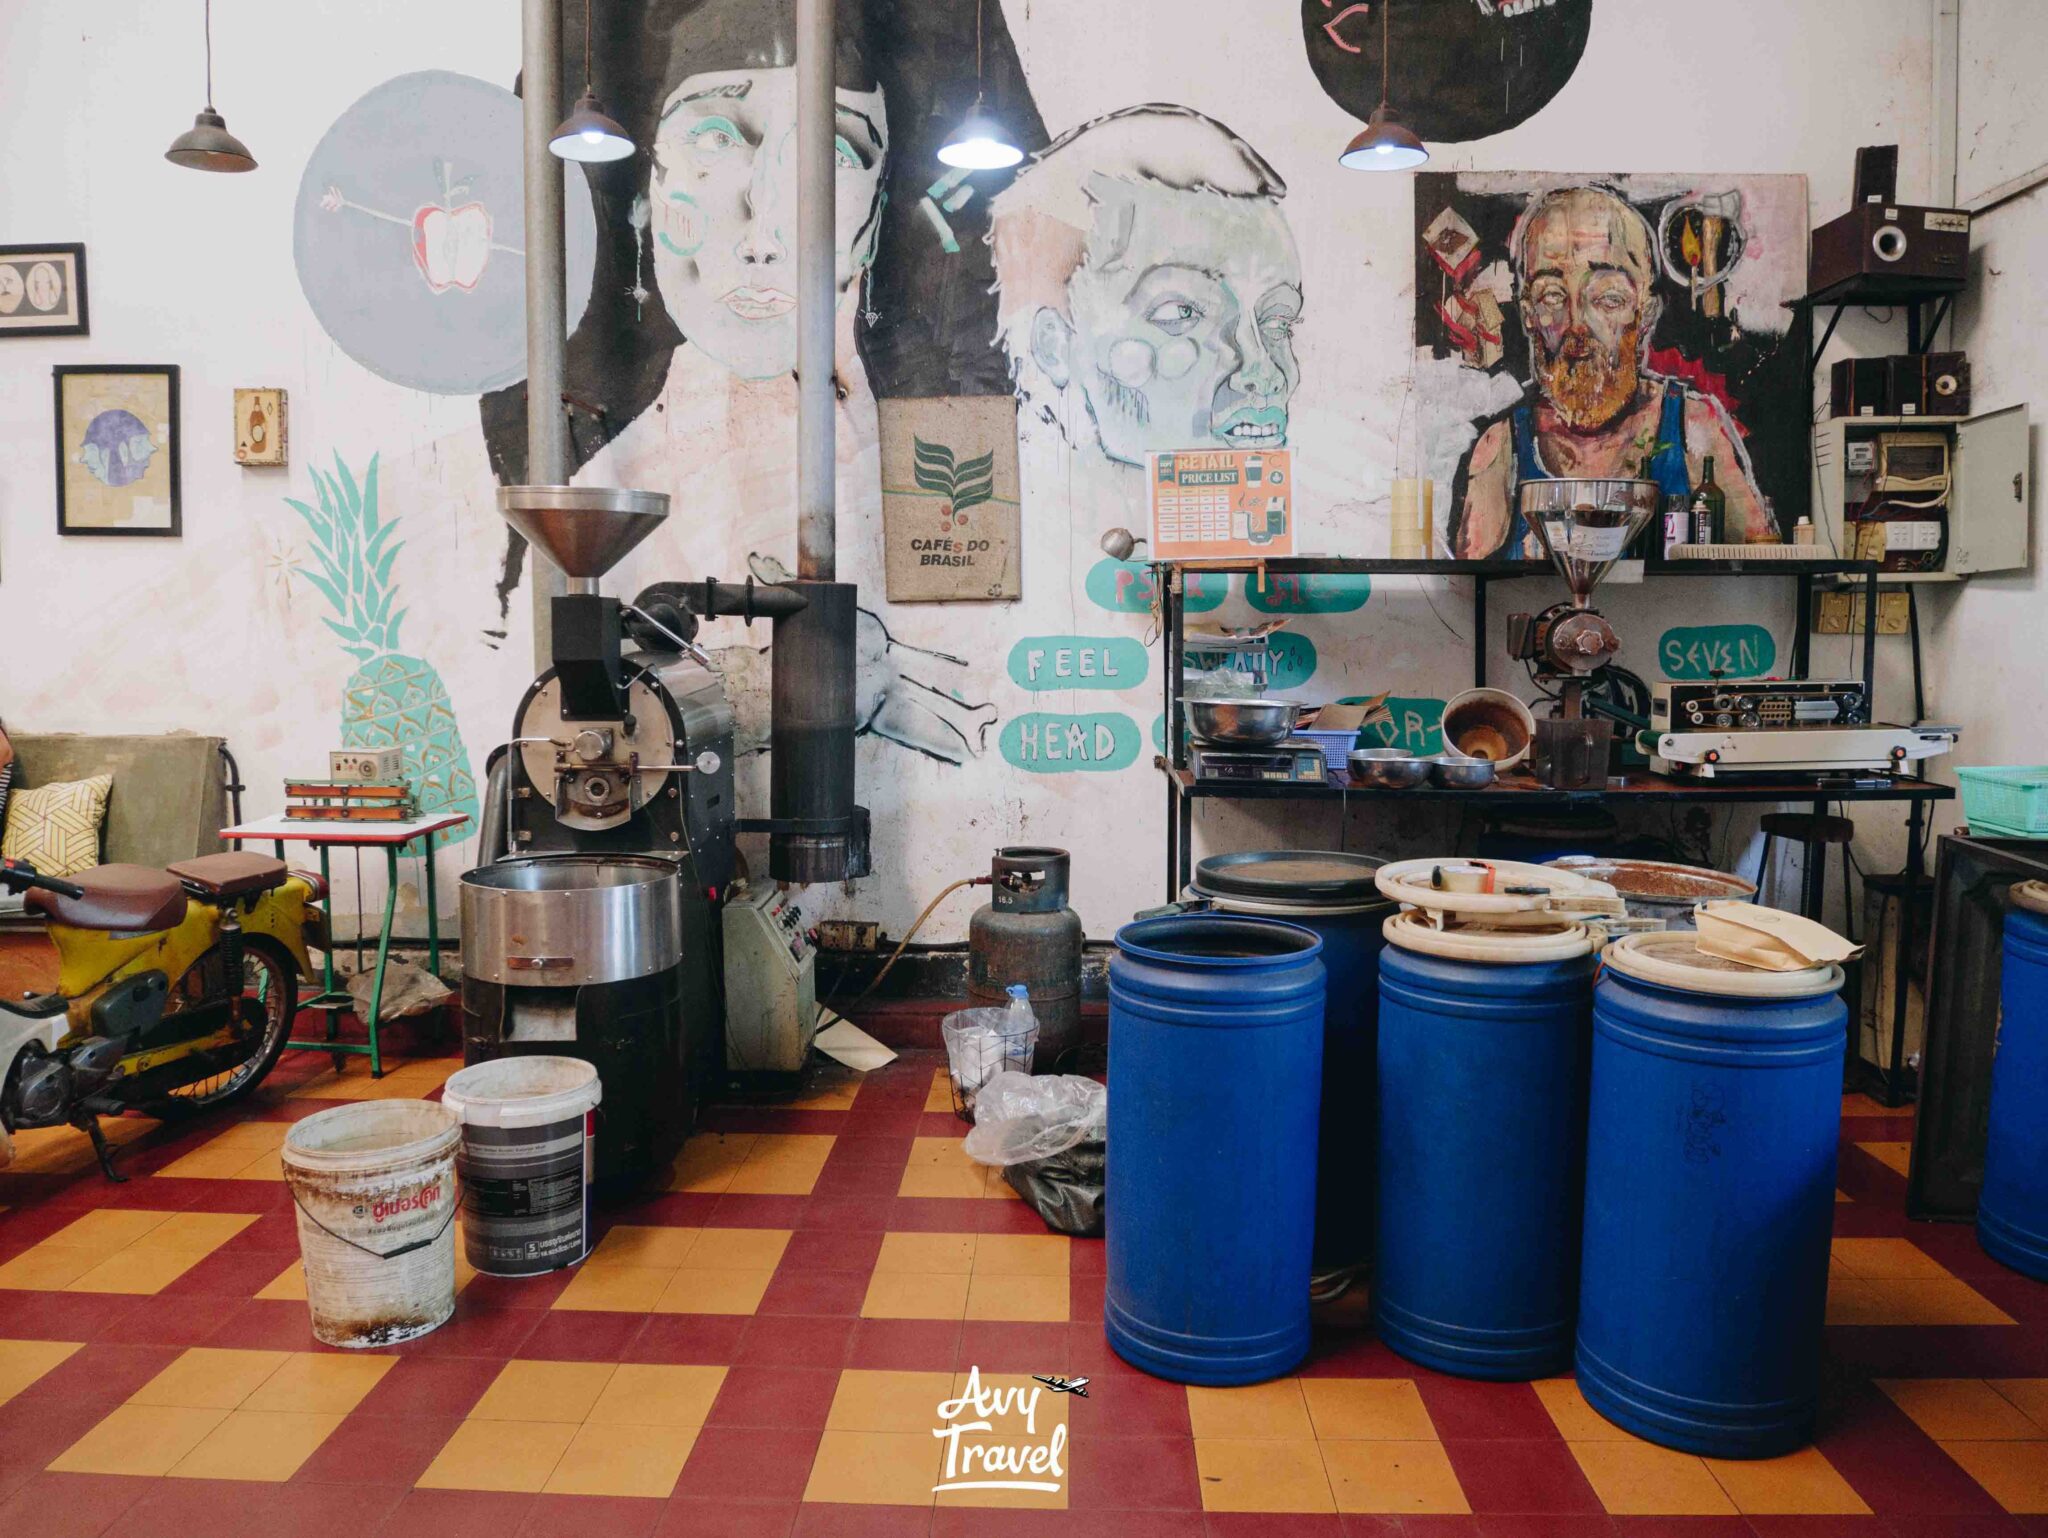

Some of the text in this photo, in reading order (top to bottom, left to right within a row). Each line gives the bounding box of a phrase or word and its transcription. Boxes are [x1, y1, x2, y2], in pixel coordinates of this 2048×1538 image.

[1178, 454, 1237, 470] RETAIL
[1181, 471, 1238, 483] PRICE LIST
[967, 539, 990, 551] DO
[920, 554, 975, 567] BRASIL
[1665, 634, 1759, 673] SEVEN
[1027, 648, 1120, 682] FEEL
[1020, 722, 1116, 761] HEAD
[528, 1243, 536, 1253] 5
